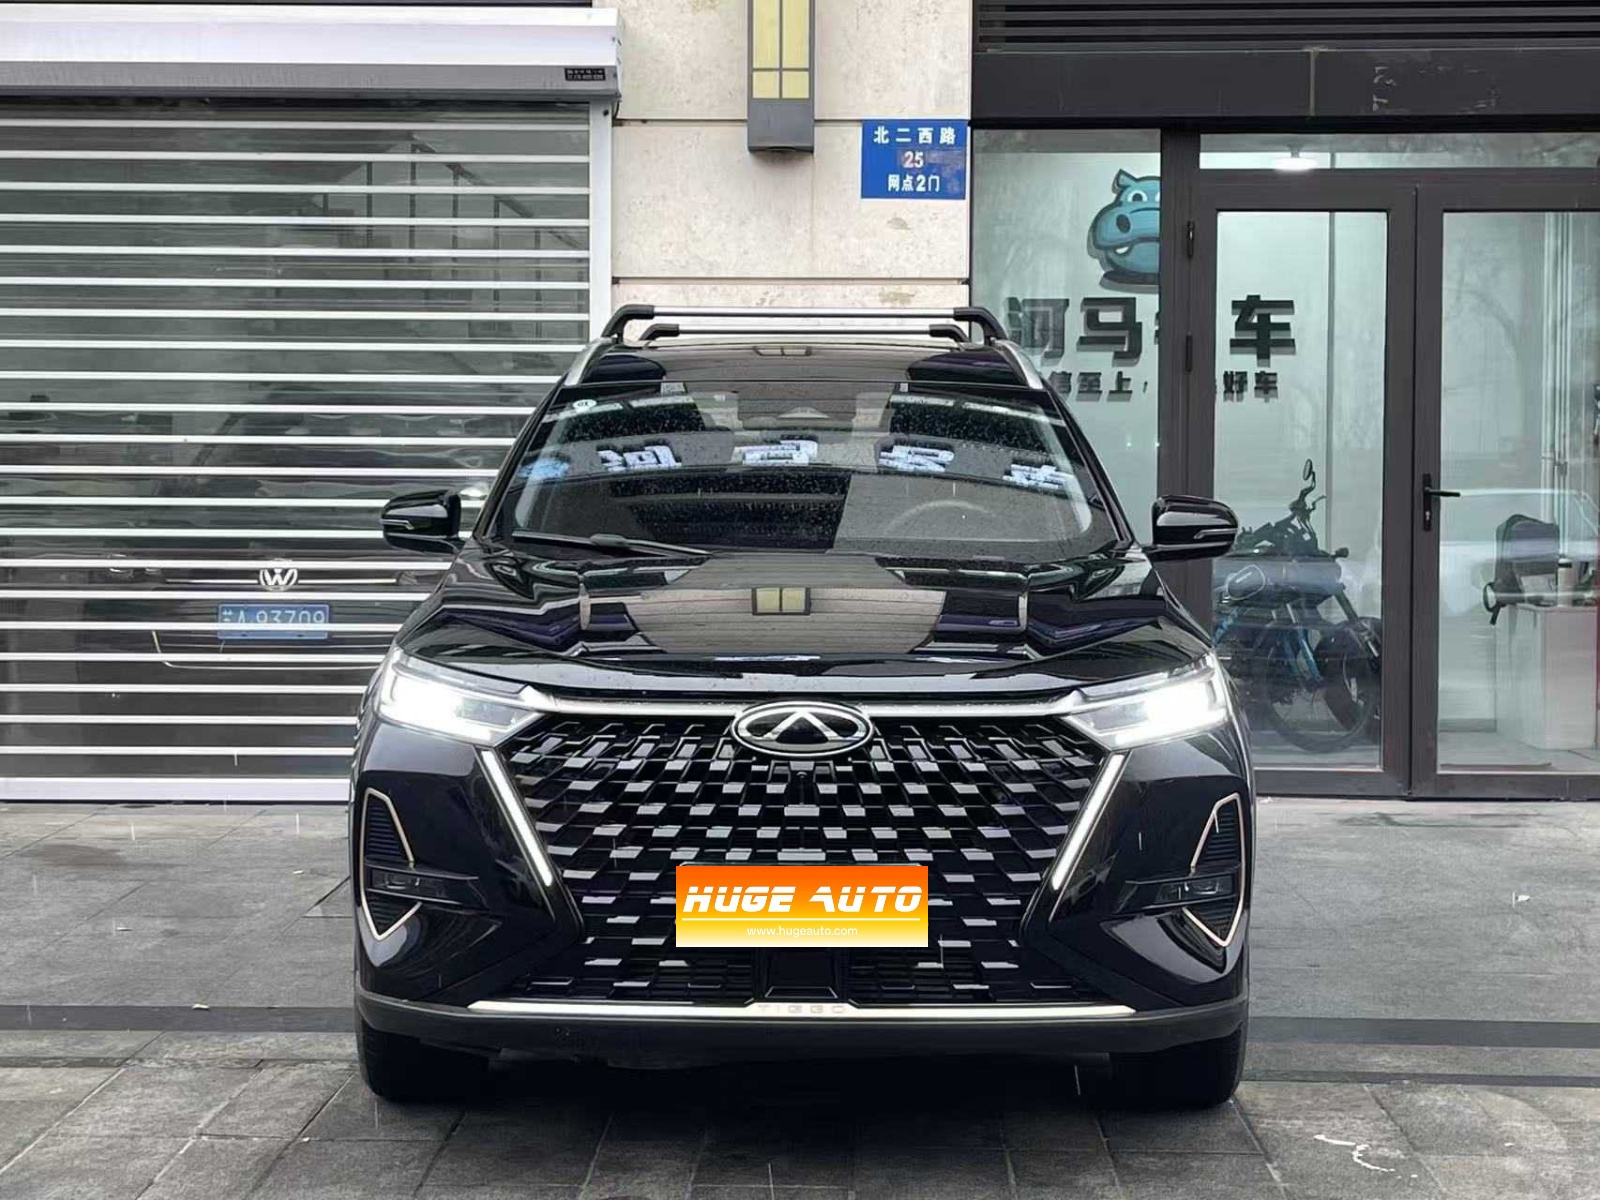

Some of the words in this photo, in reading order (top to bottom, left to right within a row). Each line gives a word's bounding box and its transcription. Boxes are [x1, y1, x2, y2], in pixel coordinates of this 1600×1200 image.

[873, 125, 956, 145] 北二西路
[903, 151, 924, 168] 25
[887, 174, 940, 192] 网点2门
